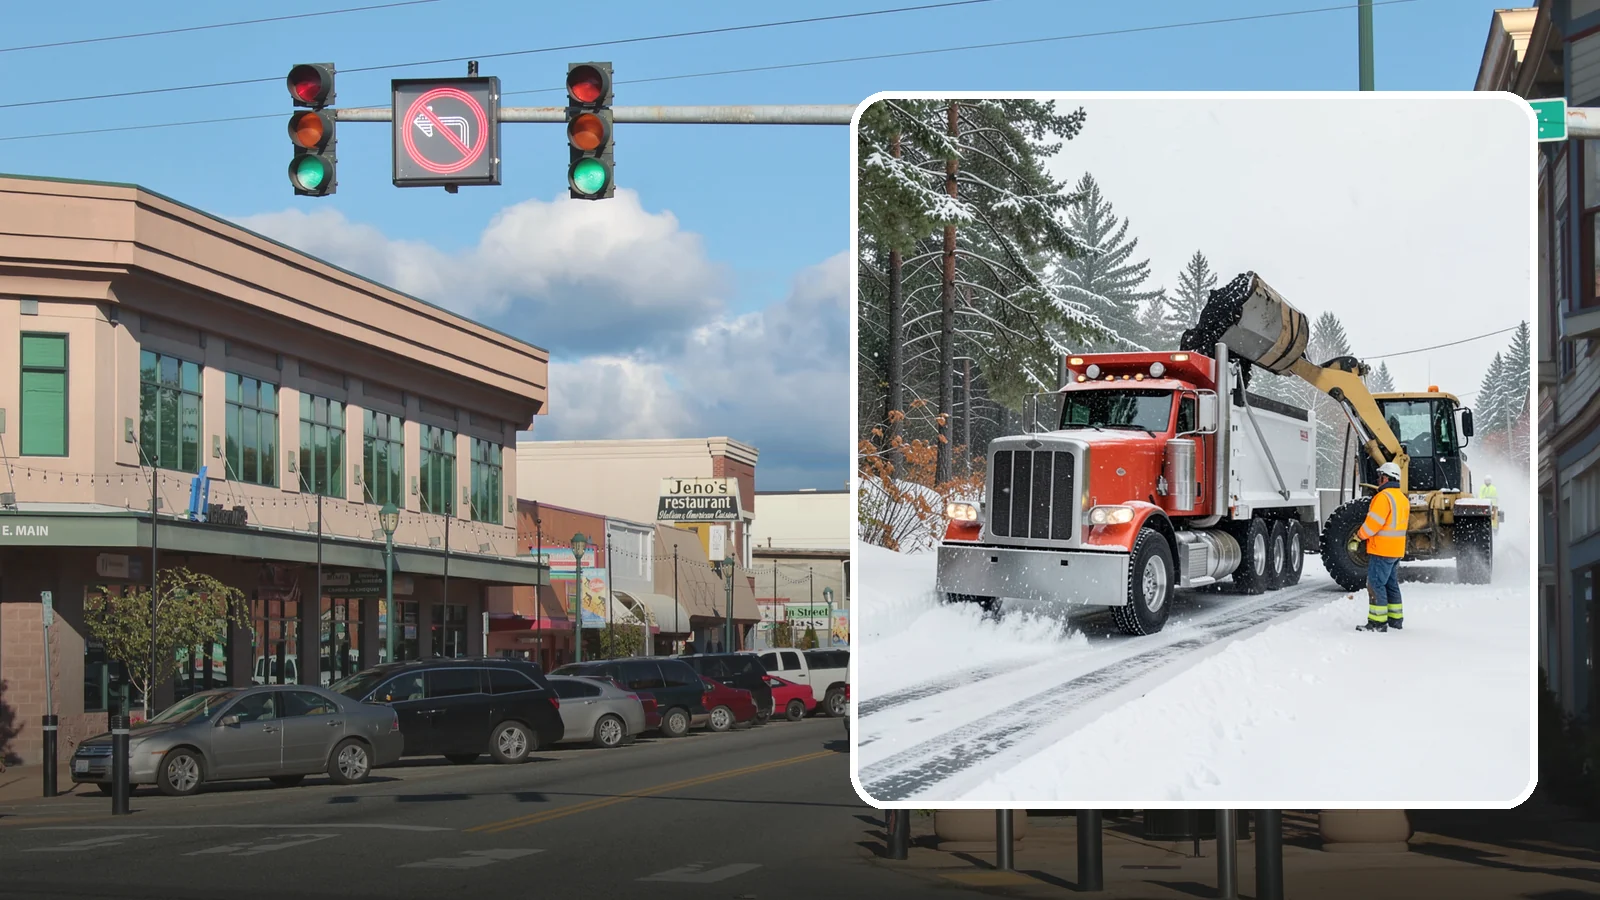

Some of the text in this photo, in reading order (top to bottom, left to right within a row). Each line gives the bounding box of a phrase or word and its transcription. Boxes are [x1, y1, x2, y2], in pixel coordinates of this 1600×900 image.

[670, 480, 727, 494] Jeno's
[665, 496, 731, 509] restaurant
[658, 509, 681, 519] Italian
[686, 509, 714, 519] American
[714, 509, 737, 519] Cuisine
[2, 525, 49, 536] E. MAIN
[797, 607, 828, 617] Street
